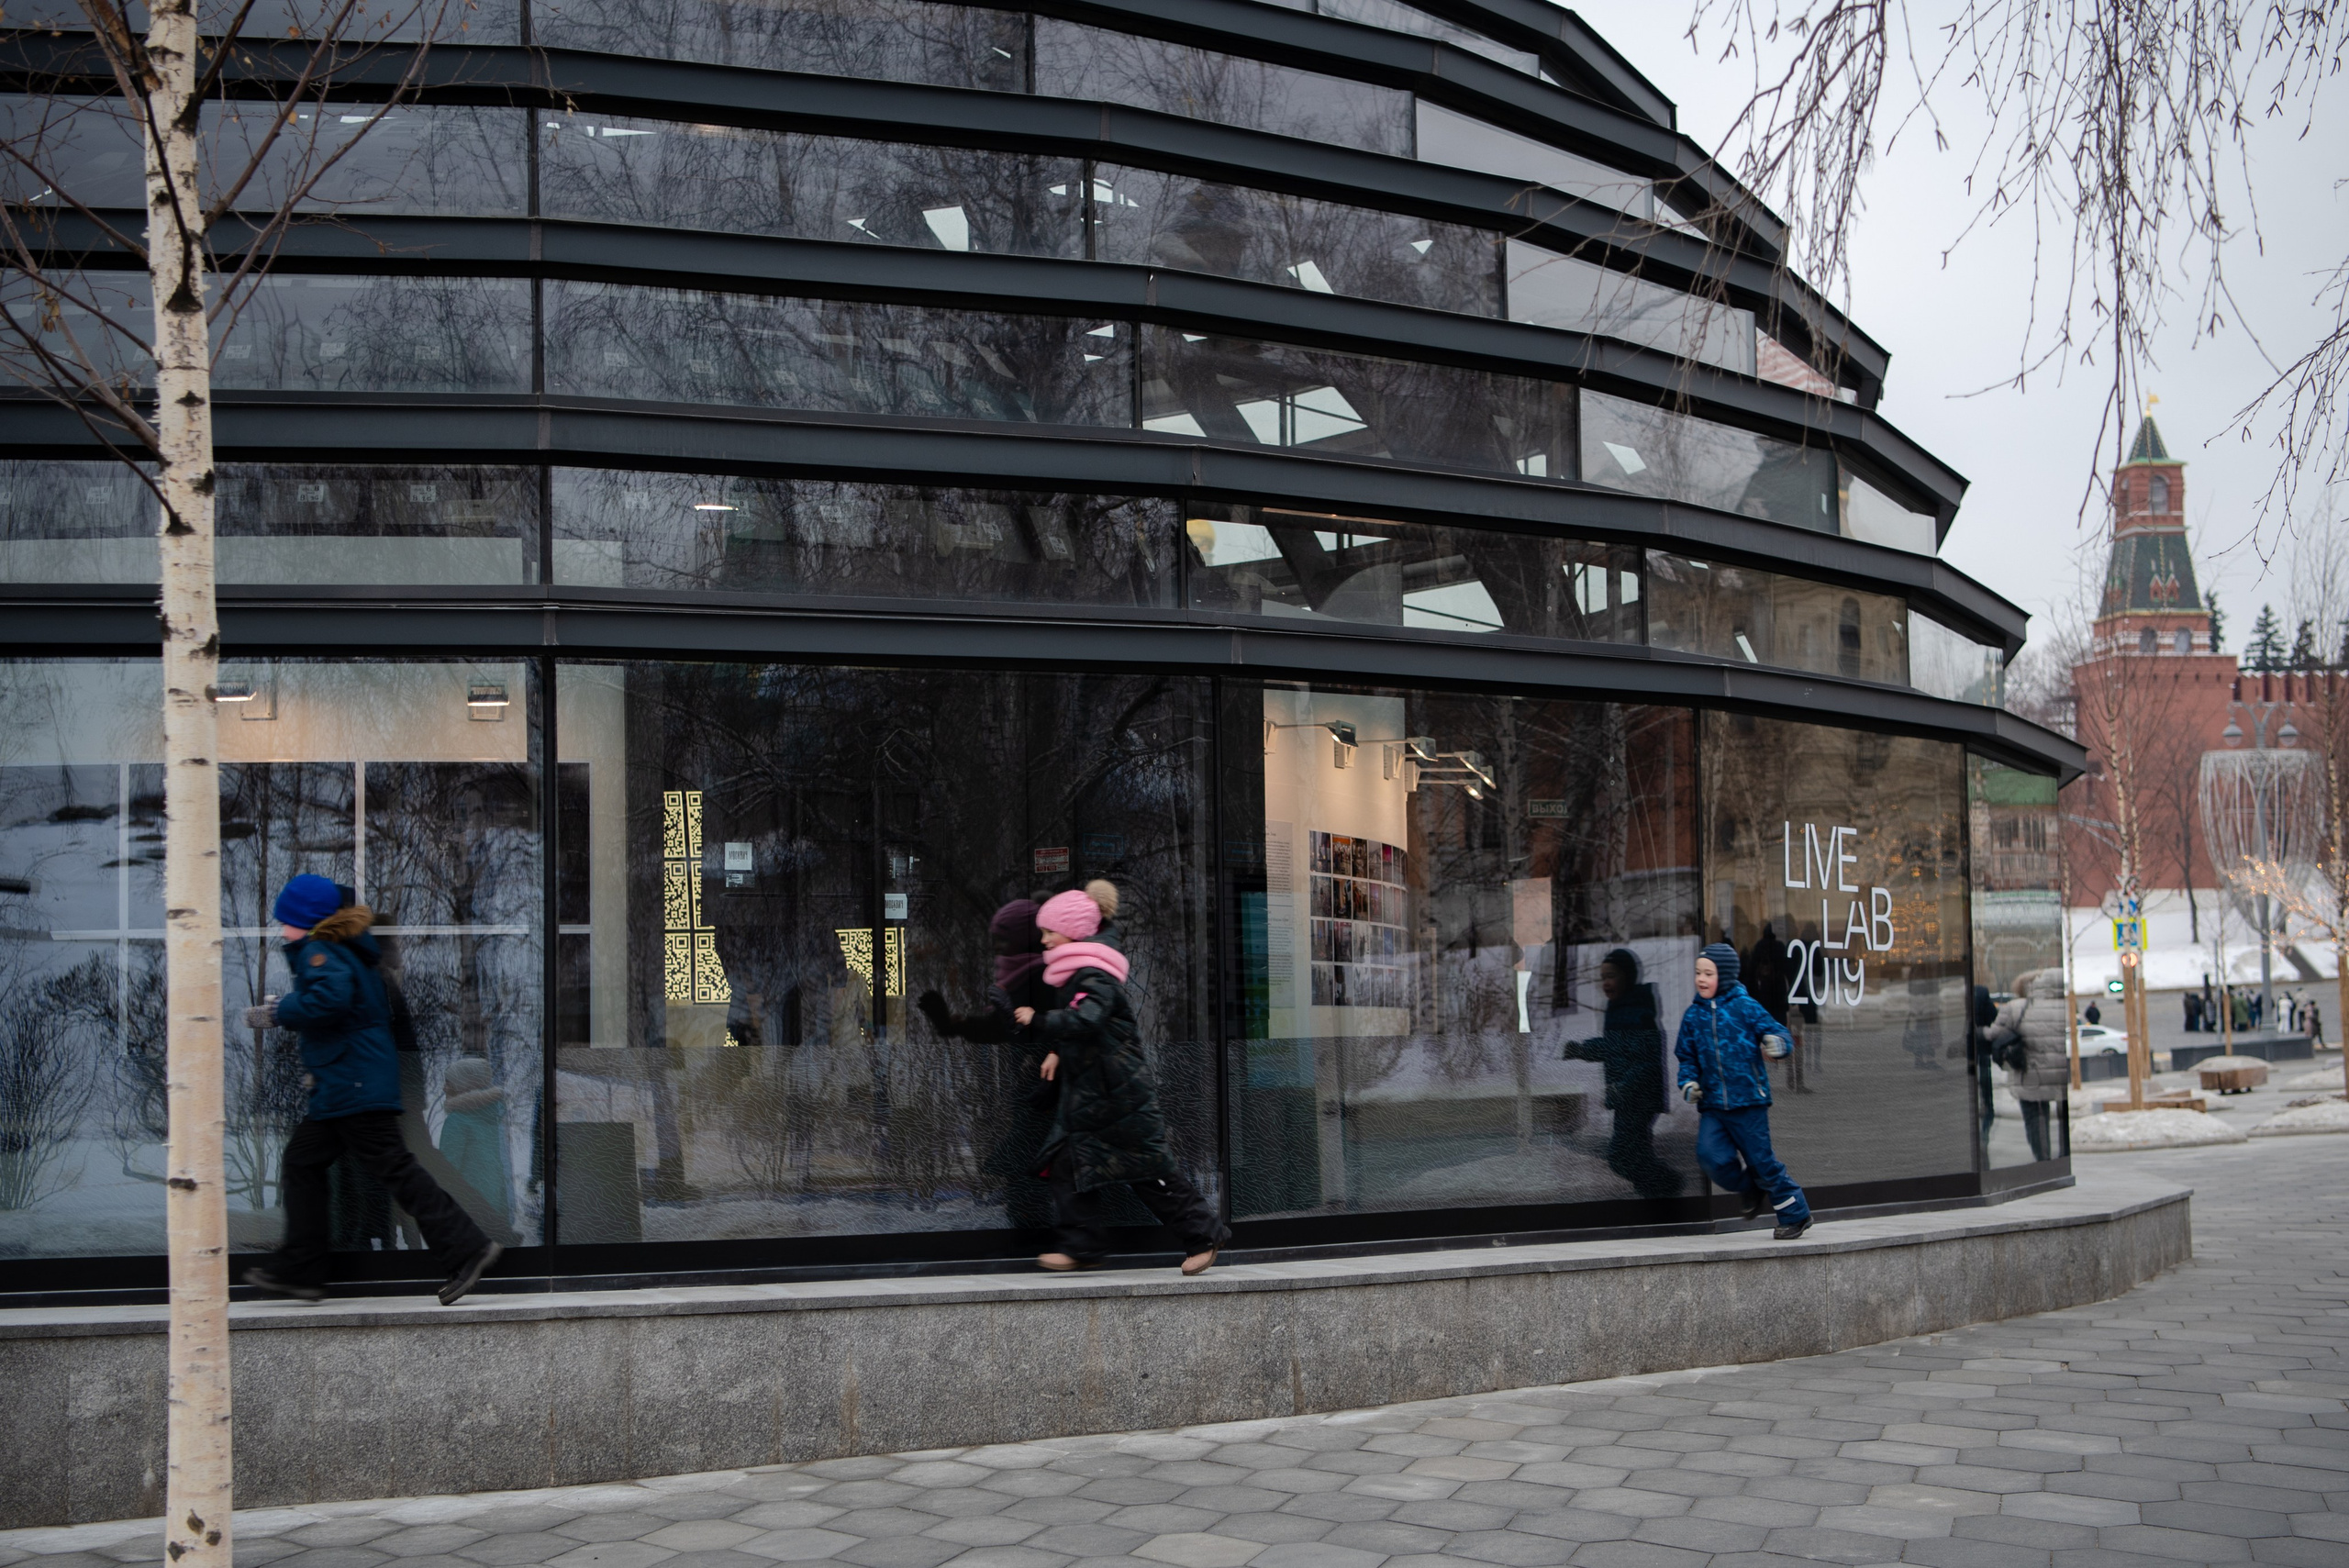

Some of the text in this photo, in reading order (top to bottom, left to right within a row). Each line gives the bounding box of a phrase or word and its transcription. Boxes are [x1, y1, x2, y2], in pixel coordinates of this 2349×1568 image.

[1785, 820, 1859, 892] LIVE
[1822, 887, 1895, 951] LAB
[1787, 939, 1865, 1006] 2019
